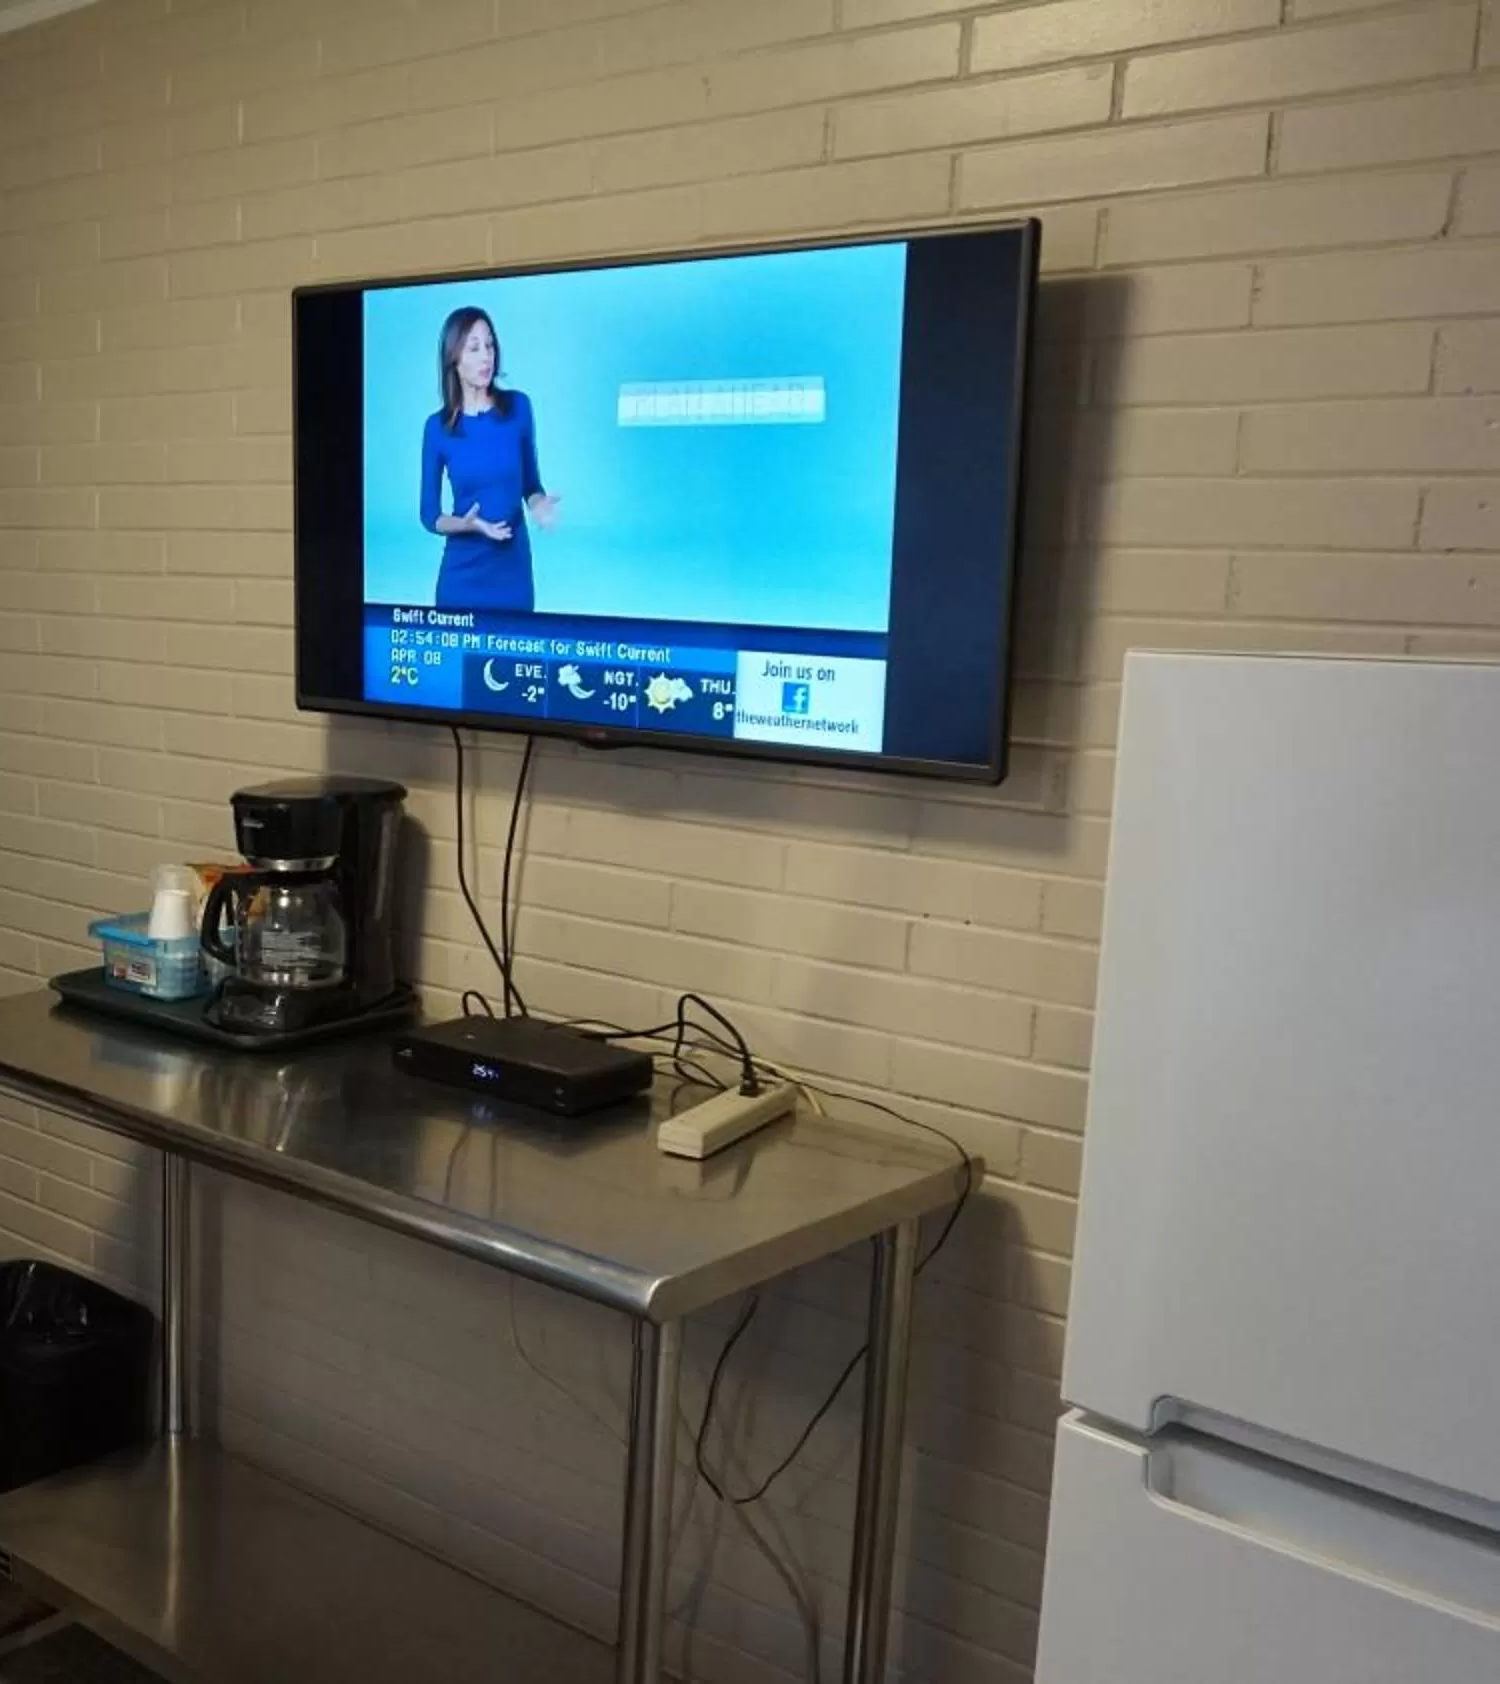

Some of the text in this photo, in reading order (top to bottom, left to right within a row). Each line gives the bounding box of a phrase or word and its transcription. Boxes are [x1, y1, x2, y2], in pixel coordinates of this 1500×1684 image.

[393, 608, 475, 627] Swift Current
[391, 630, 481, 649] 02:54:08 PM
[487, 635, 671, 663] Forecast for Swift Current
[391, 648, 441, 665] APR 08
[515, 663, 548, 679] EVE.
[604, 671, 639, 687] NGT.
[762, 660, 836, 682] Join us on
[736, 708, 860, 735] theweathernetwork
